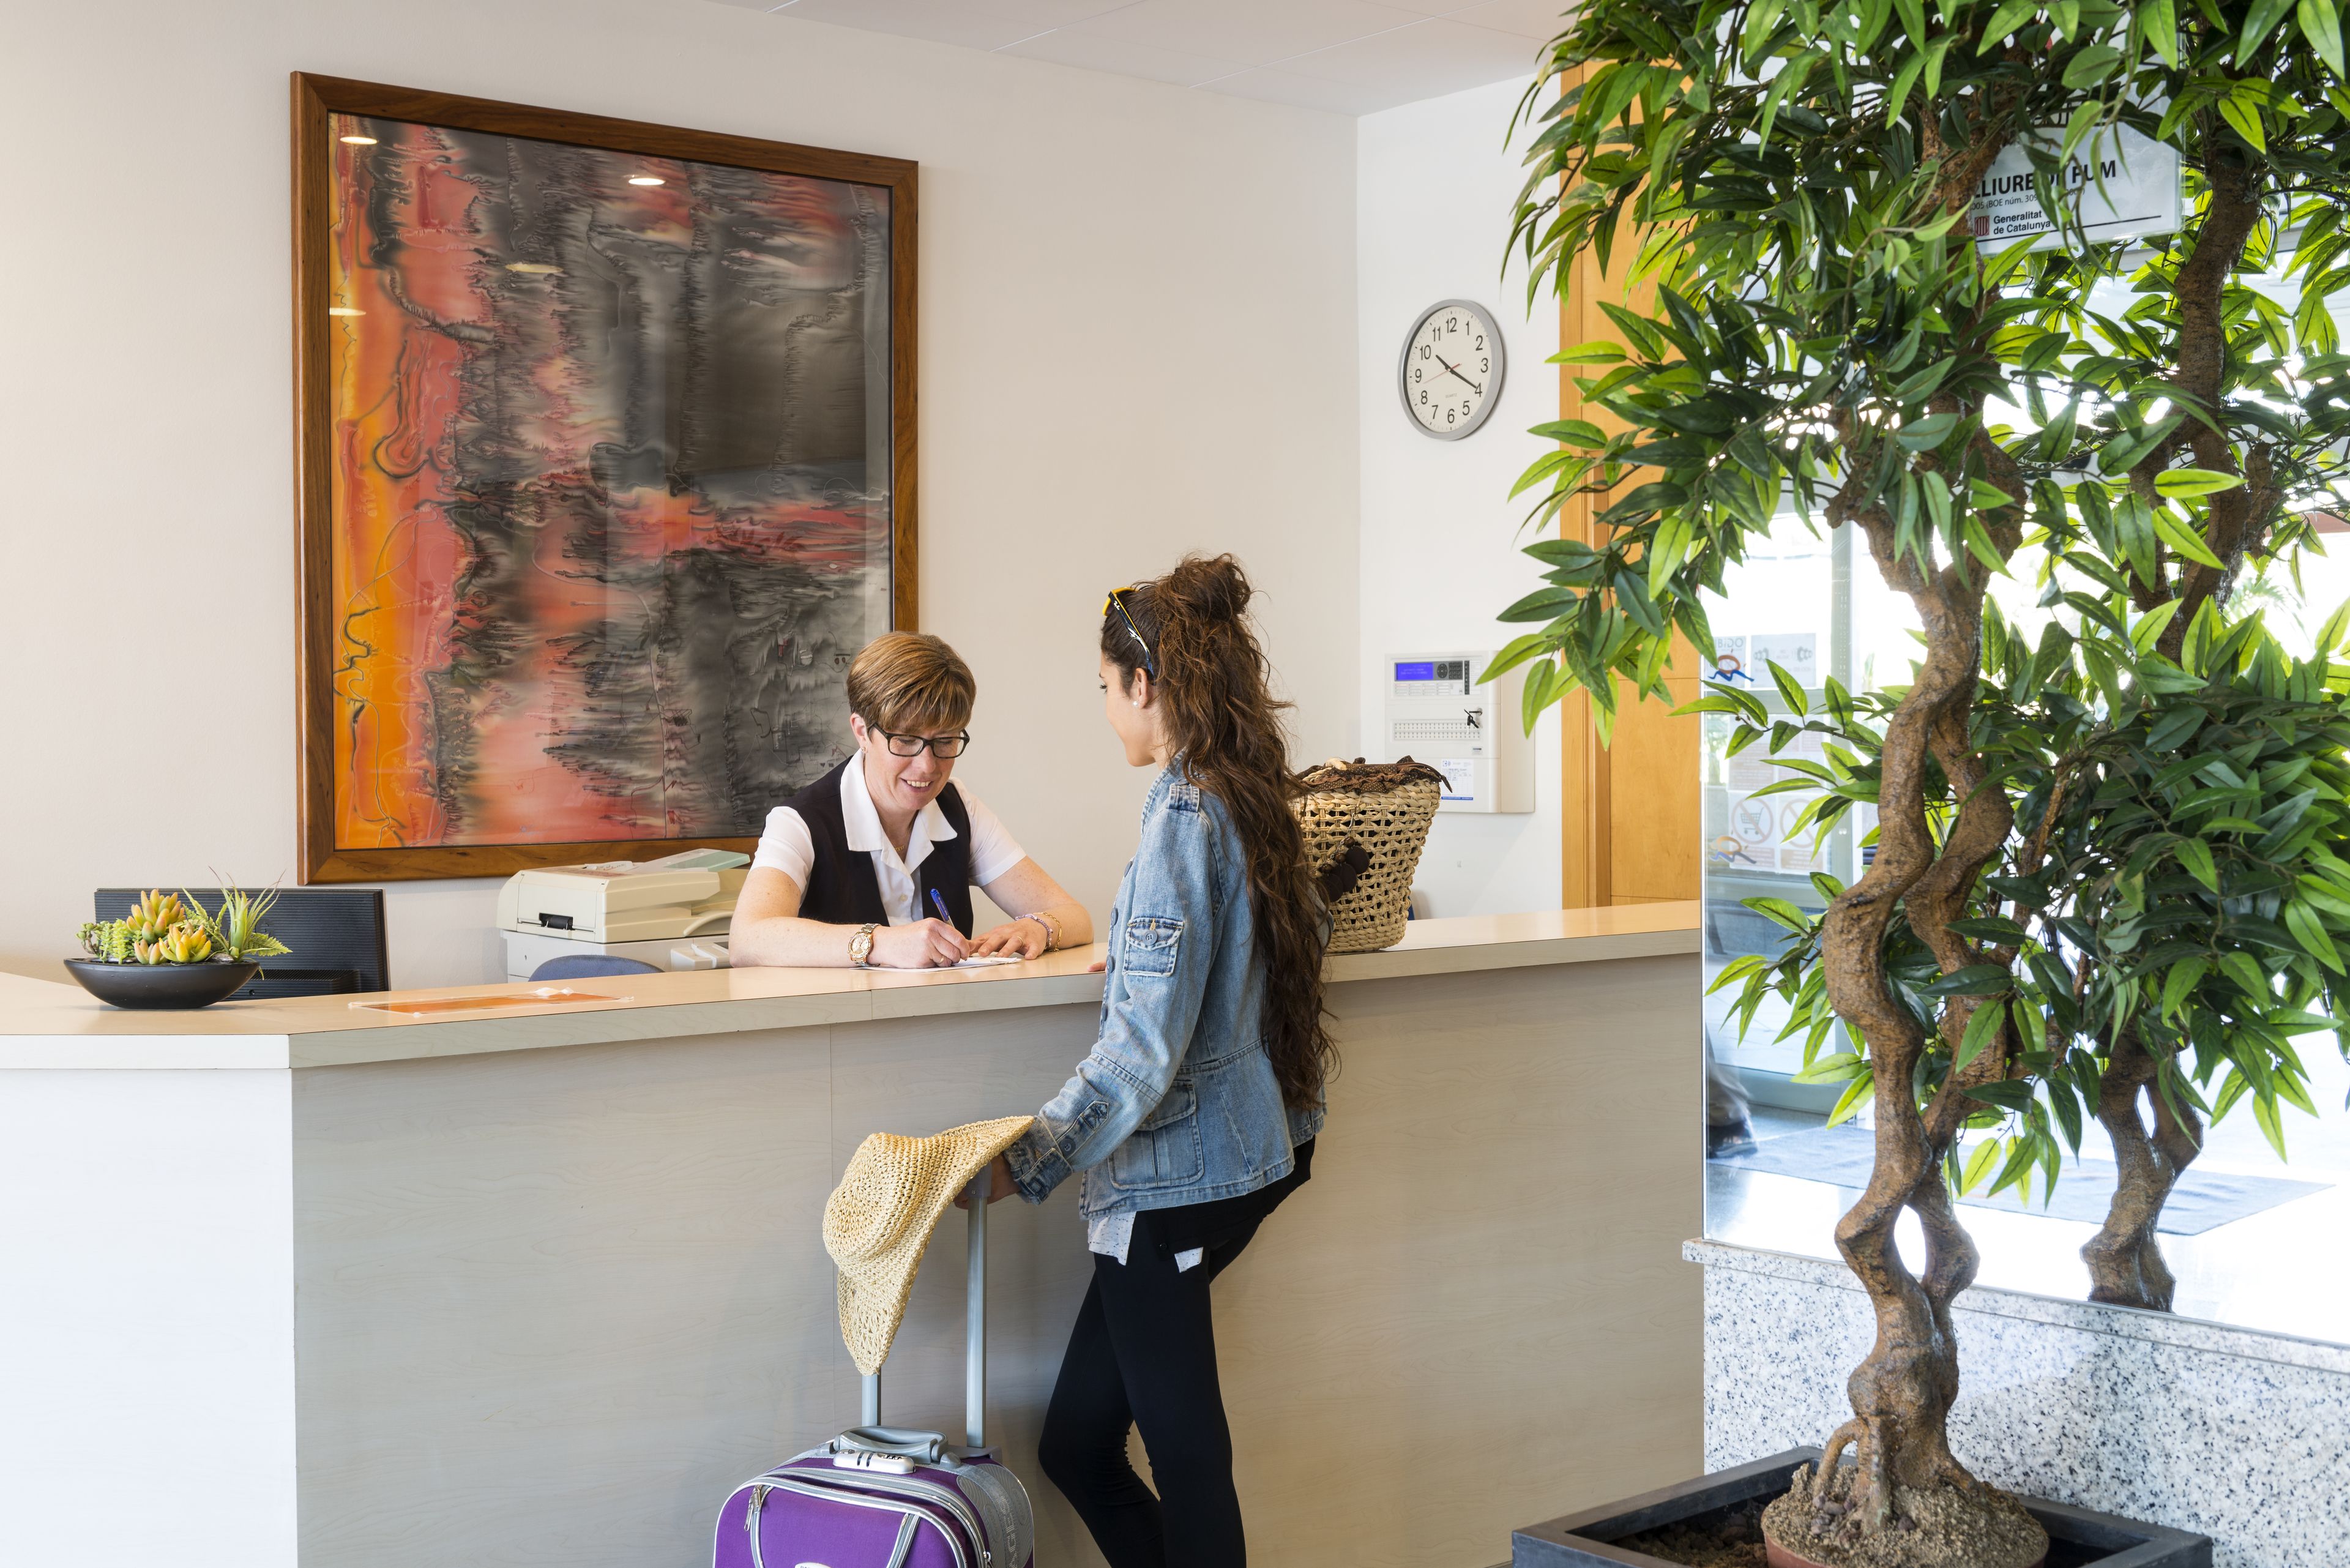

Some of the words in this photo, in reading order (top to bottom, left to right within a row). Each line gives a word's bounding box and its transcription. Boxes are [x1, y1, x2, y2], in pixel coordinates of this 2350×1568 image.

[1986, 199, 2003, 209] (BOE
[2005, 196, 2023, 205] núm.
[1993, 210, 2042, 224] Generalitat
[2007, 221, 2051, 233] Catalunya
[1445, 317, 1457, 334] 12
[1466, 320, 1469, 336] 1
[1432, 326, 1441, 342] 11
[1475, 335, 1483, 351] 2
[1419, 344, 1431, 361] 10
[1480, 357, 1489, 373] 3
[1415, 368, 1422, 384] 9
[1420, 390, 1428, 405] 8
[1474, 383, 1483, 398] 4
[1431, 405, 1439, 420] 7
[1462, 400, 1471, 416] 5
[1447, 409, 1455, 424] 6
